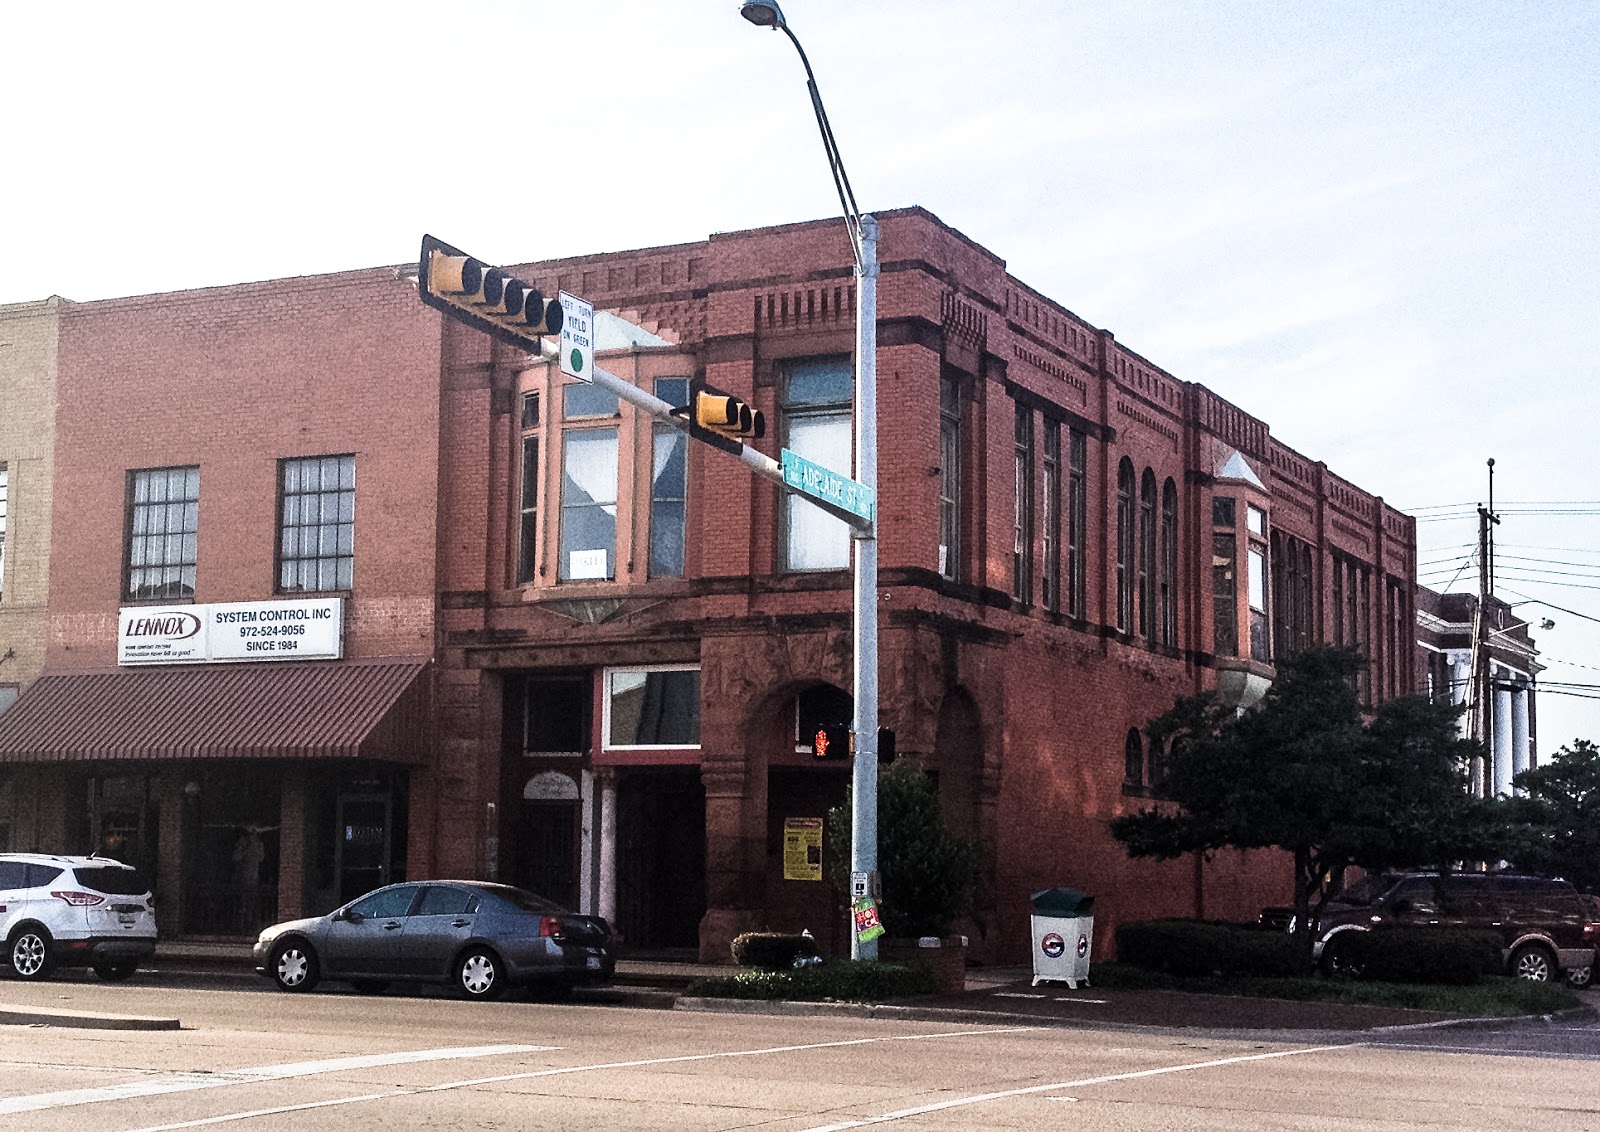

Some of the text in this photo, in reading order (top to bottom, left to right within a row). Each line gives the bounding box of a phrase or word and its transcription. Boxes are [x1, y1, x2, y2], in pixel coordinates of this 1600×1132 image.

[568, 316, 586, 332] YIELD
[563, 329, 570, 340] ON
[573, 333, 589, 347] GREEN
[803, 465, 843, 500] ADELAIDE
[847, 486, 856, 507] ST
[216, 608, 331, 623] SYSTEM CONTROL INC
[126, 617, 186, 636] LENNOX
[240, 624, 305, 637] 972-524-9056
[246, 640, 298, 651] SINCE 1984
